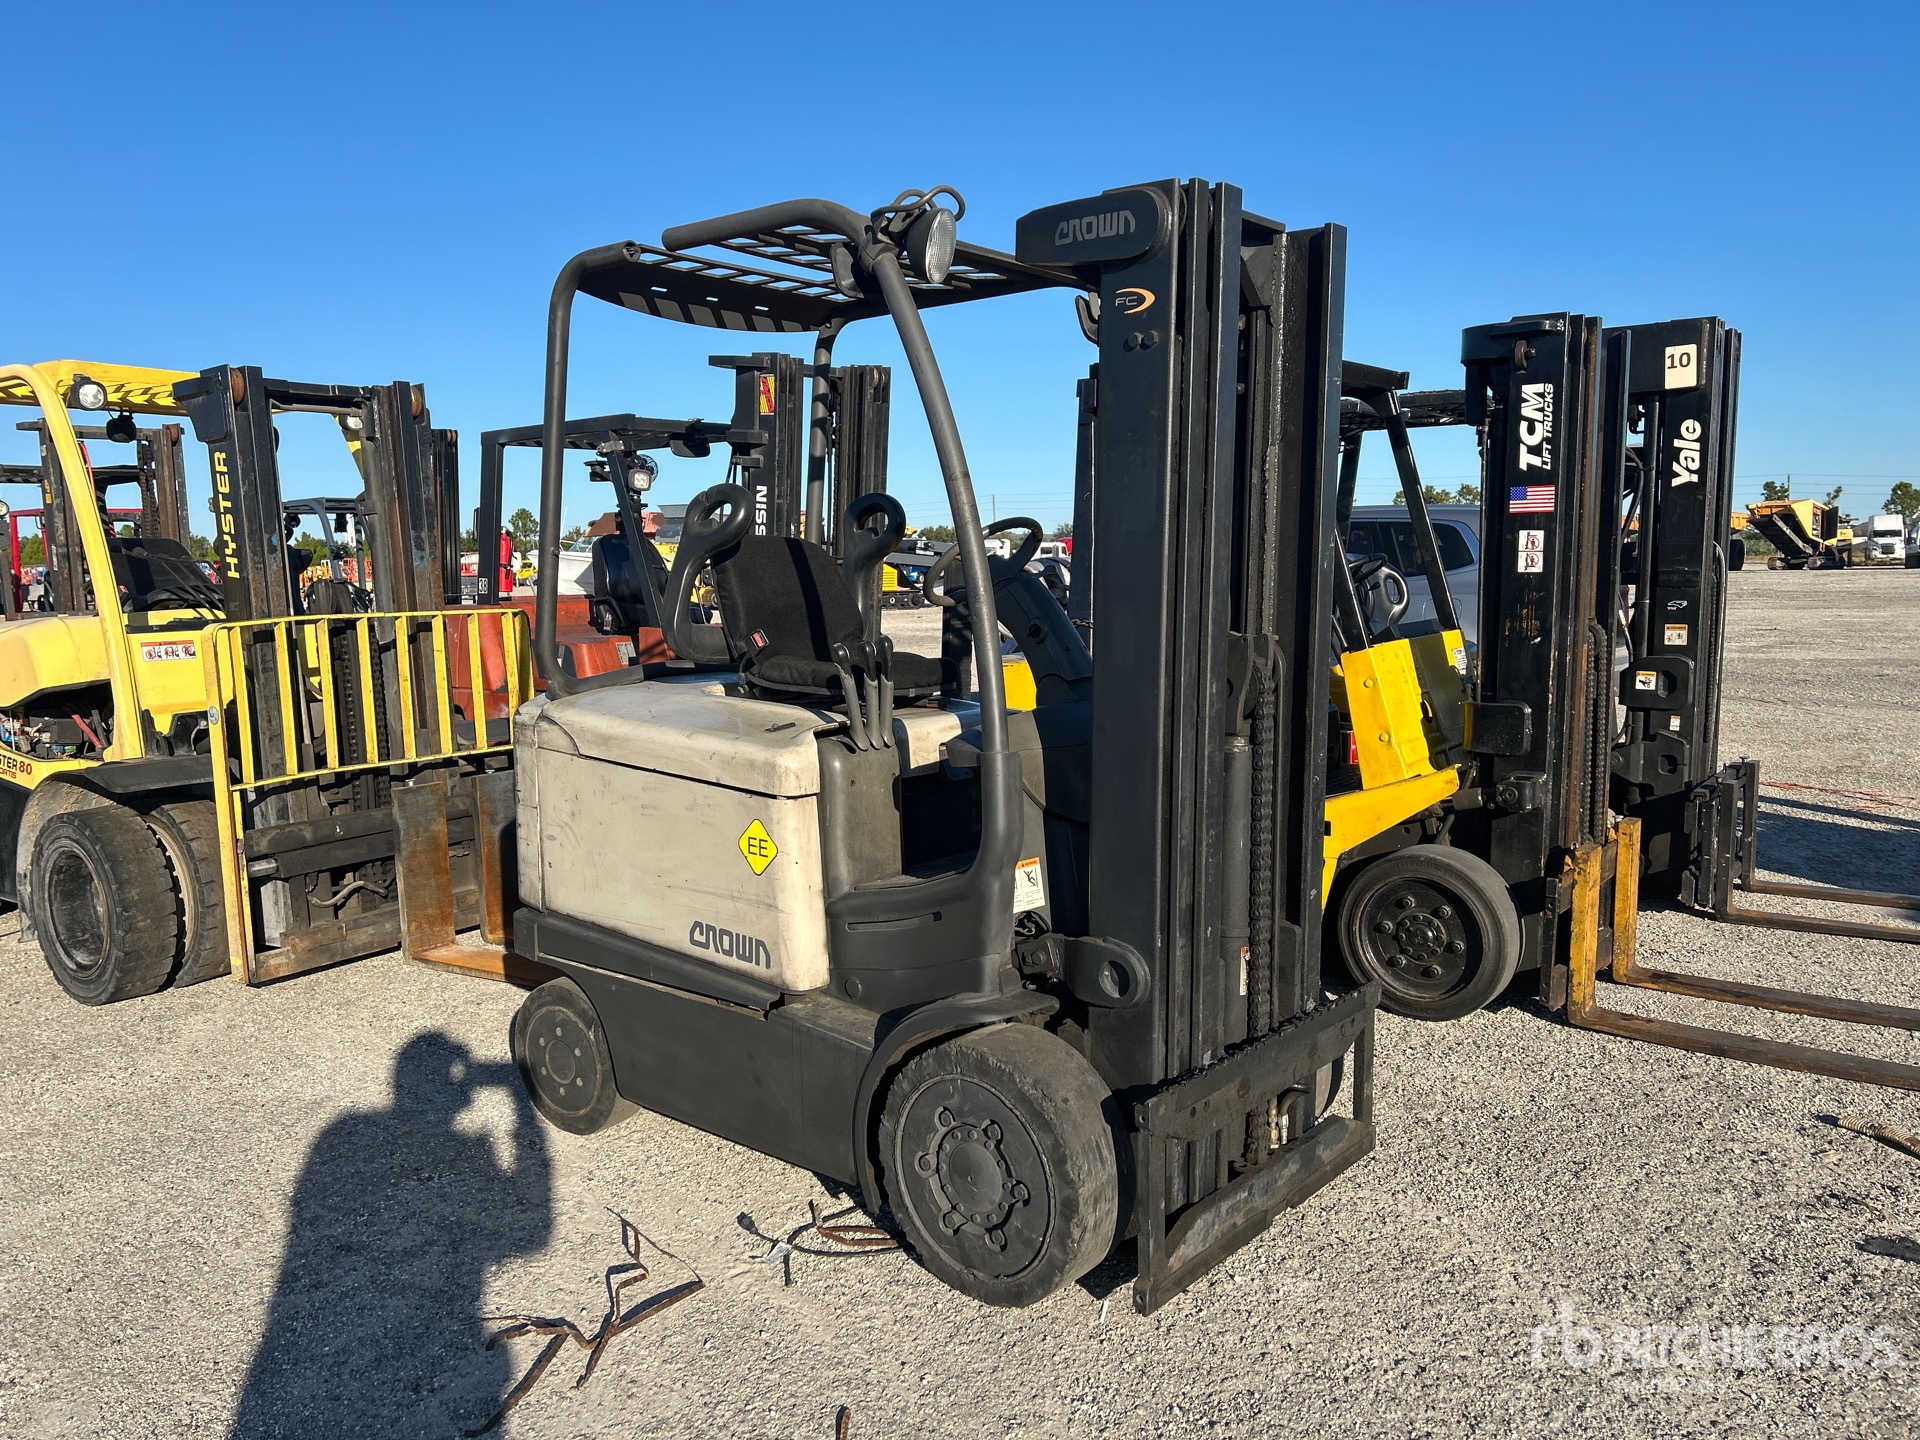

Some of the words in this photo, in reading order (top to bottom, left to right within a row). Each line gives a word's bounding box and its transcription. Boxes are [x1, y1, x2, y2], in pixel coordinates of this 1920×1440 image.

[1055, 210, 1136, 246] CROWN
[1115, 296, 1138, 307] FC
[1667, 352, 1691, 370] 10
[1519, 383, 1545, 472] TCM
[1543, 383, 1554, 438] TRUCKS
[1542, 441, 1552, 471] LIFT
[1671, 418, 1702, 488] Yale
[214, 451, 240, 579] HYSTER
[19, 761, 33, 775] 80
[748, 836, 769, 858] EE
[689, 920, 772, 970] CROWN
